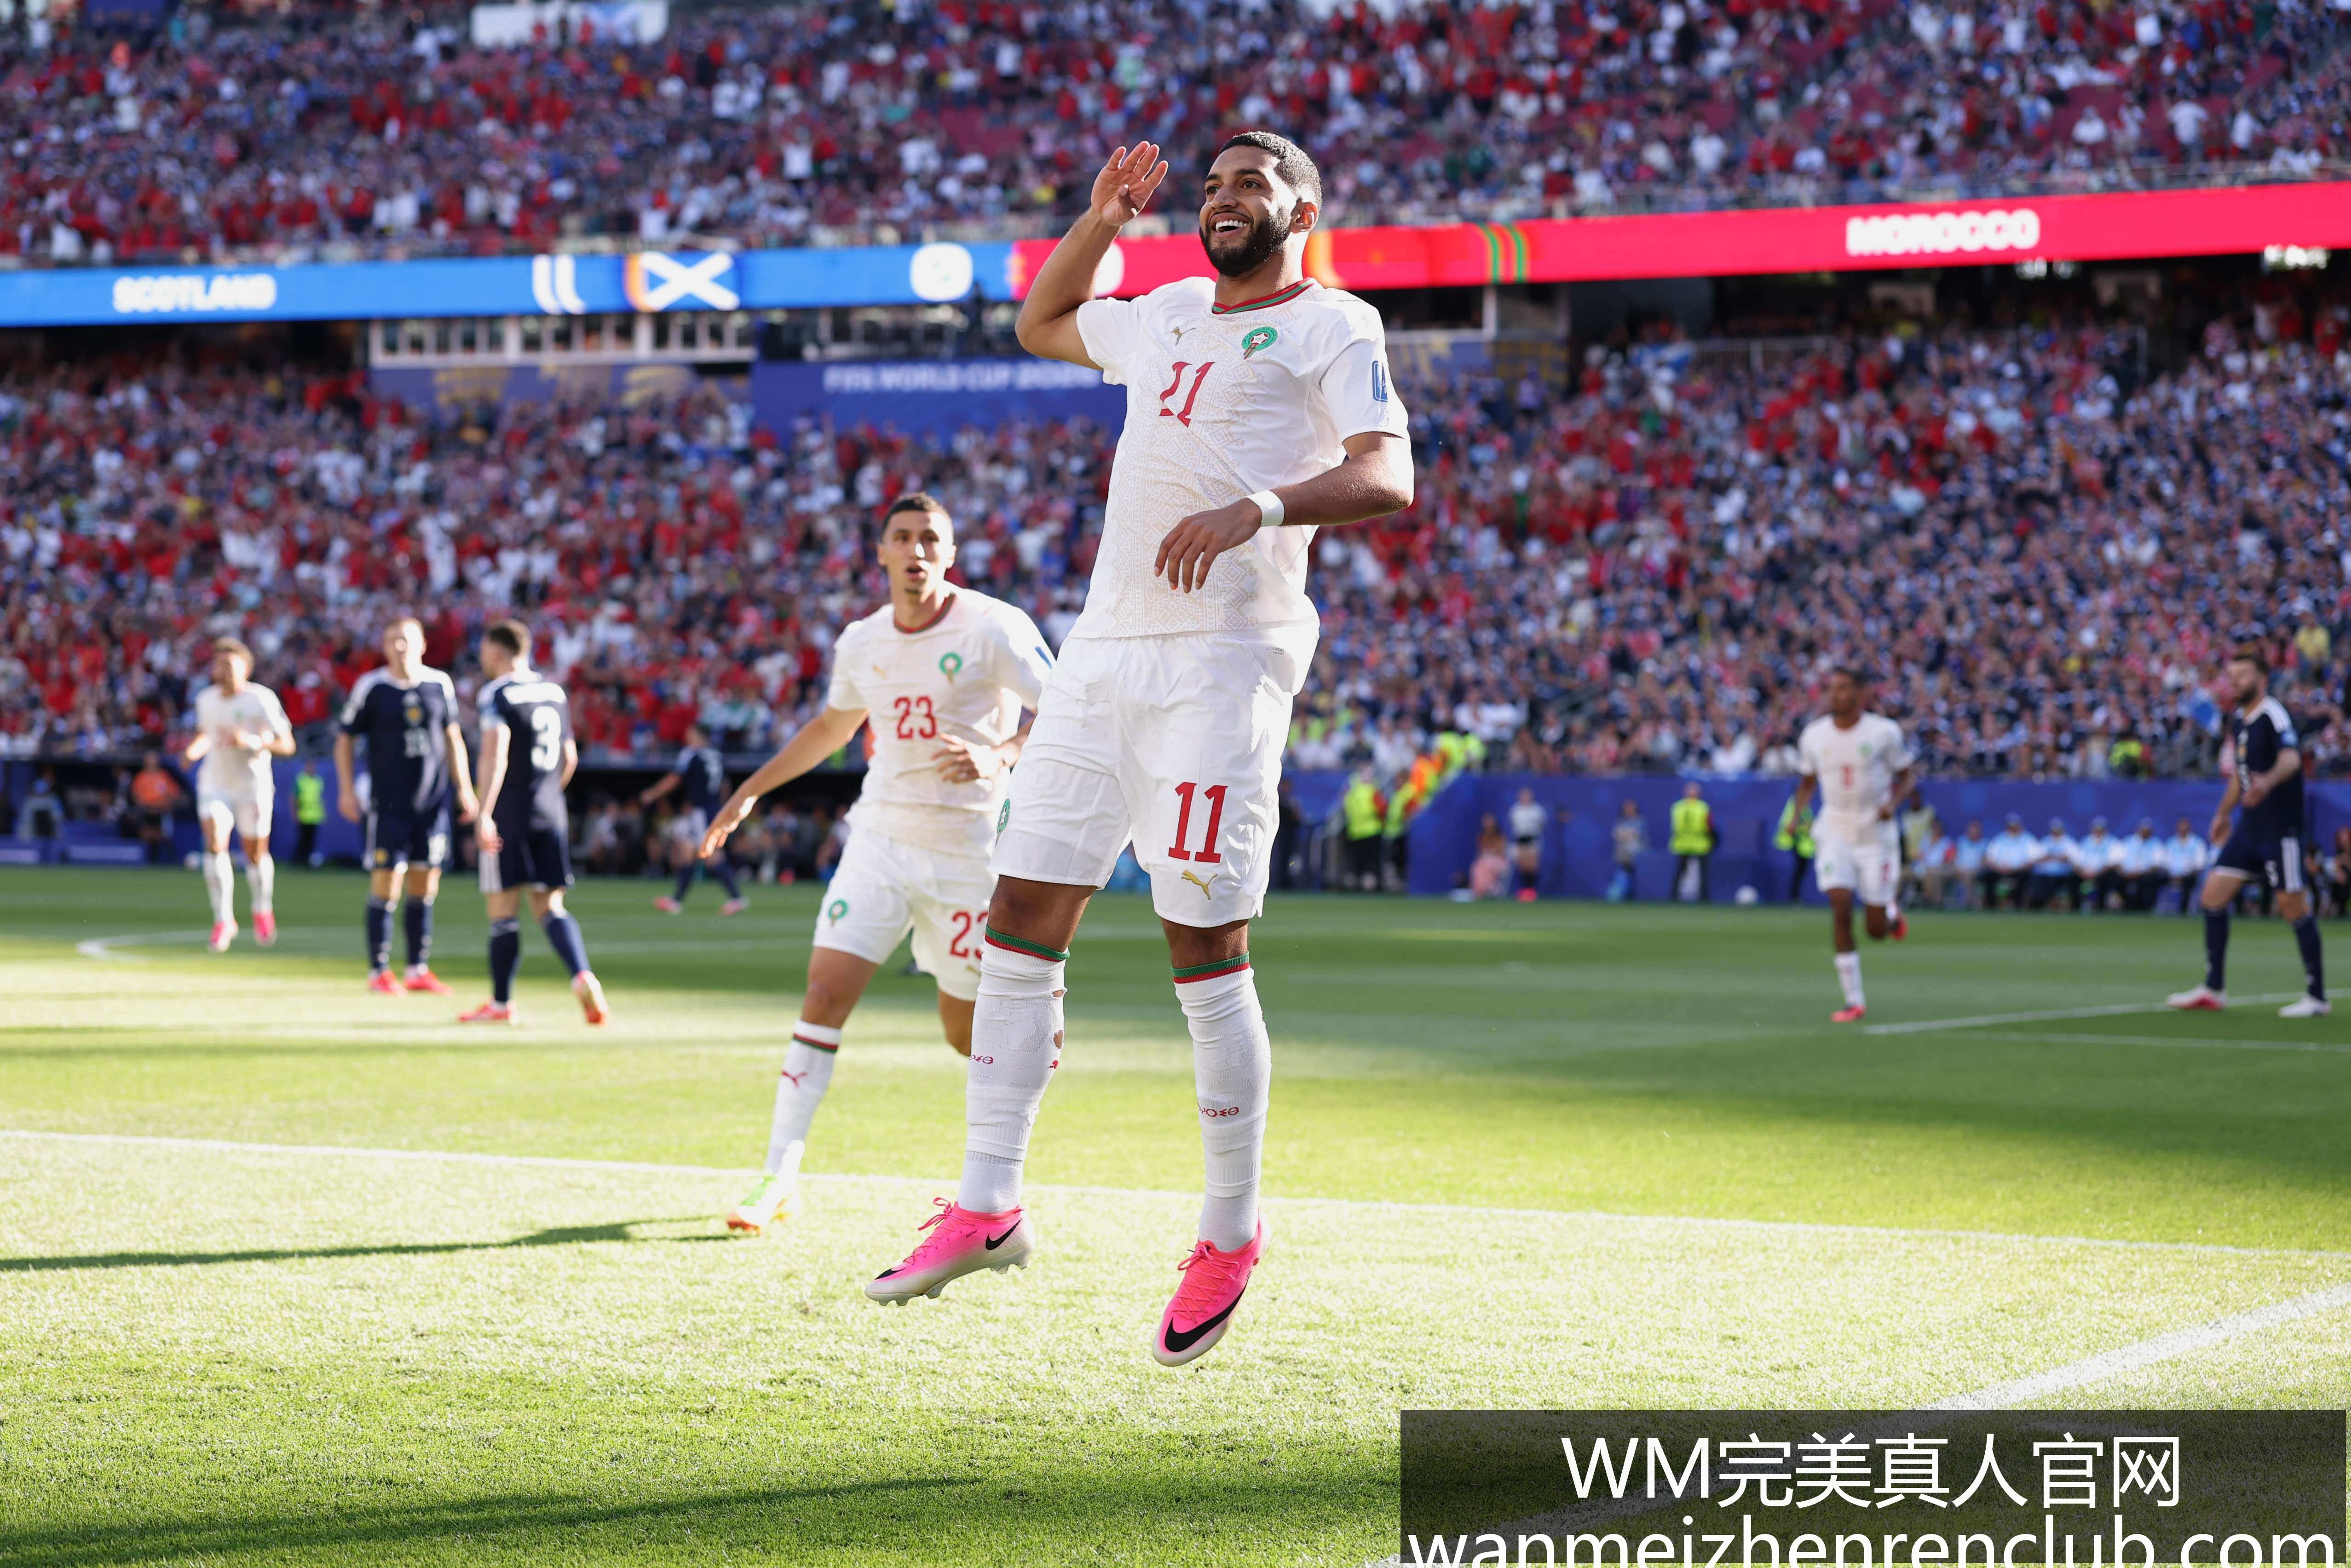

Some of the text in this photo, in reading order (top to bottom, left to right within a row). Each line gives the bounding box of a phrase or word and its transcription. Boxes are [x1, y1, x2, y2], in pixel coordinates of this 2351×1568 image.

[1846, 209, 2040, 255] MOROCCO
[113, 274, 276, 312] SCOTLAND
[530, 705, 561, 772] 3
[894, 696, 937, 739] 23
[1168, 782, 1228, 863] 11
